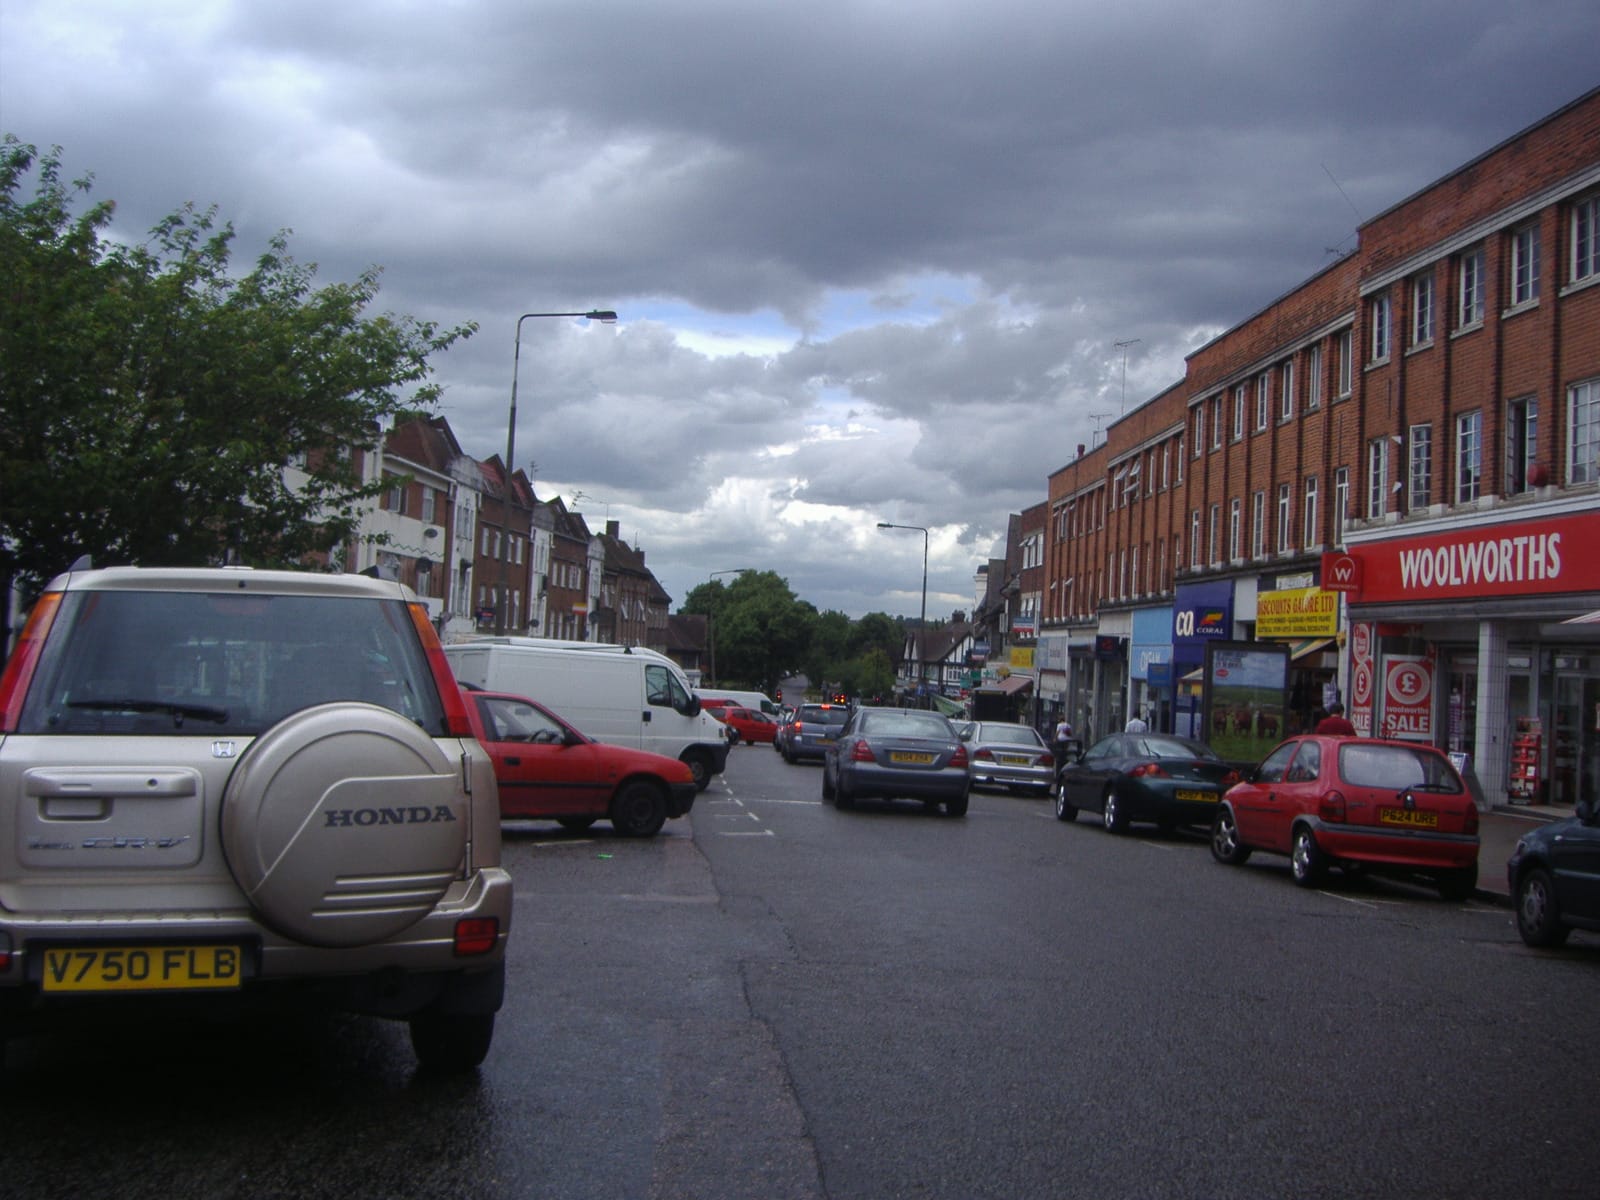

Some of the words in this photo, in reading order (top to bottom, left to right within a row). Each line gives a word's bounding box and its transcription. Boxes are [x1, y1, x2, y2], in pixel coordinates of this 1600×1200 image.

[1400, 532, 1561, 589] WOOLWORTHS
[1257, 598, 1291, 615] DISCOUNTS
[1293, 596, 1319, 613] GALORE
[1321, 595, 1334, 613] LTD
[1176, 611, 1194, 636] CO
[1387, 714, 1429, 731] SALE
[324, 795, 457, 827] HONDA
[49, 951, 150, 983] V750
[163, 949, 236, 980] FLB
